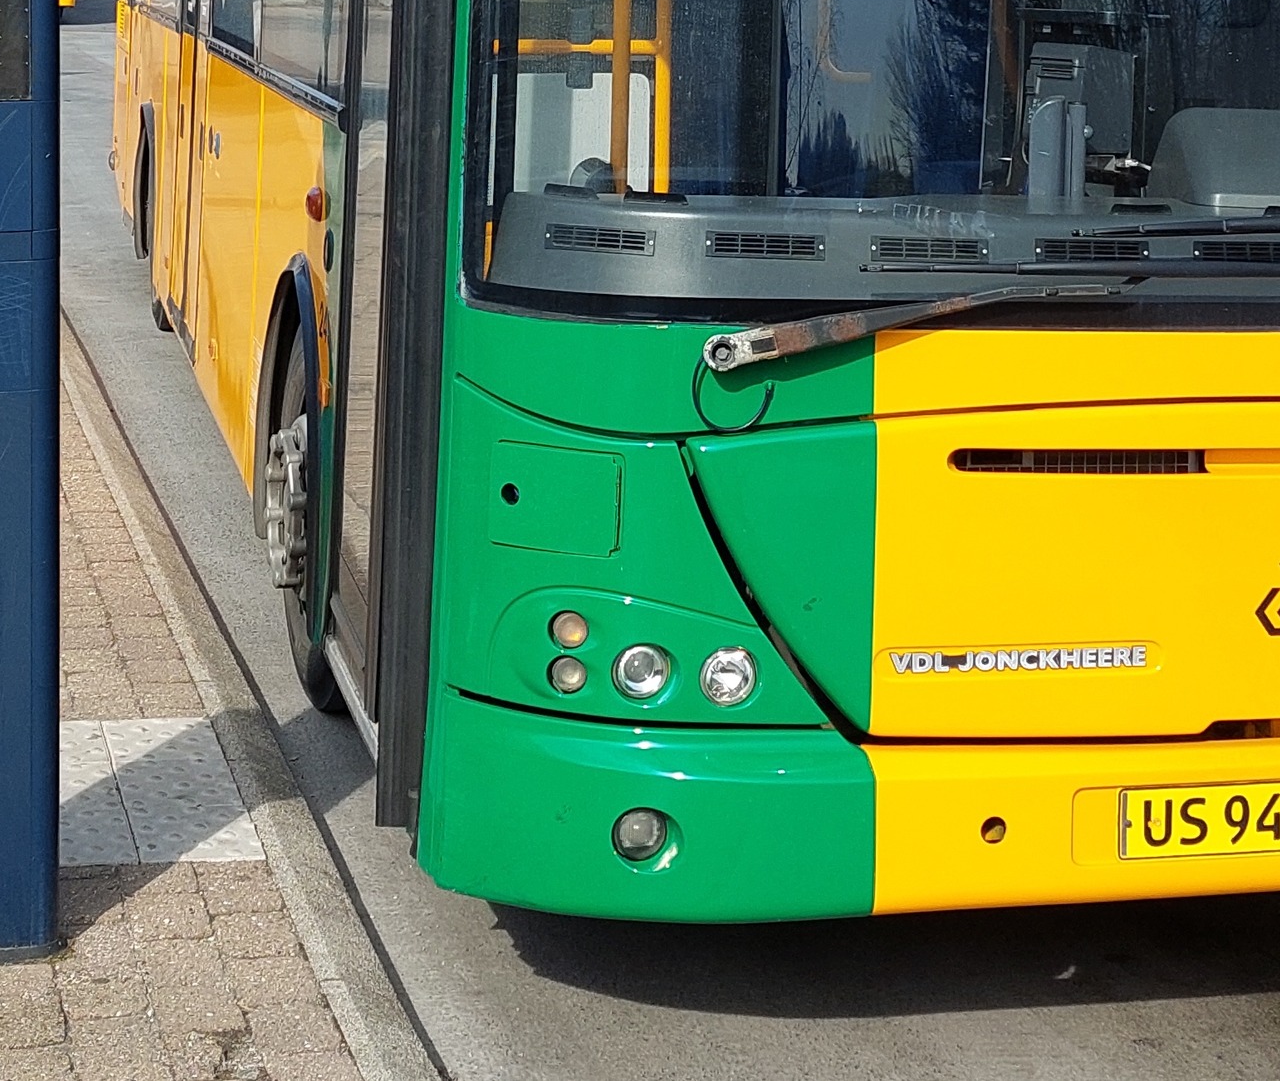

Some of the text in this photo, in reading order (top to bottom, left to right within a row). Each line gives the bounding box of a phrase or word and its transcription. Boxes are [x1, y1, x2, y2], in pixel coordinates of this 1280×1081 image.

[889, 645, 1148, 674] VDL JONCKHEERE
[1143, 797, 1209, 848] US
